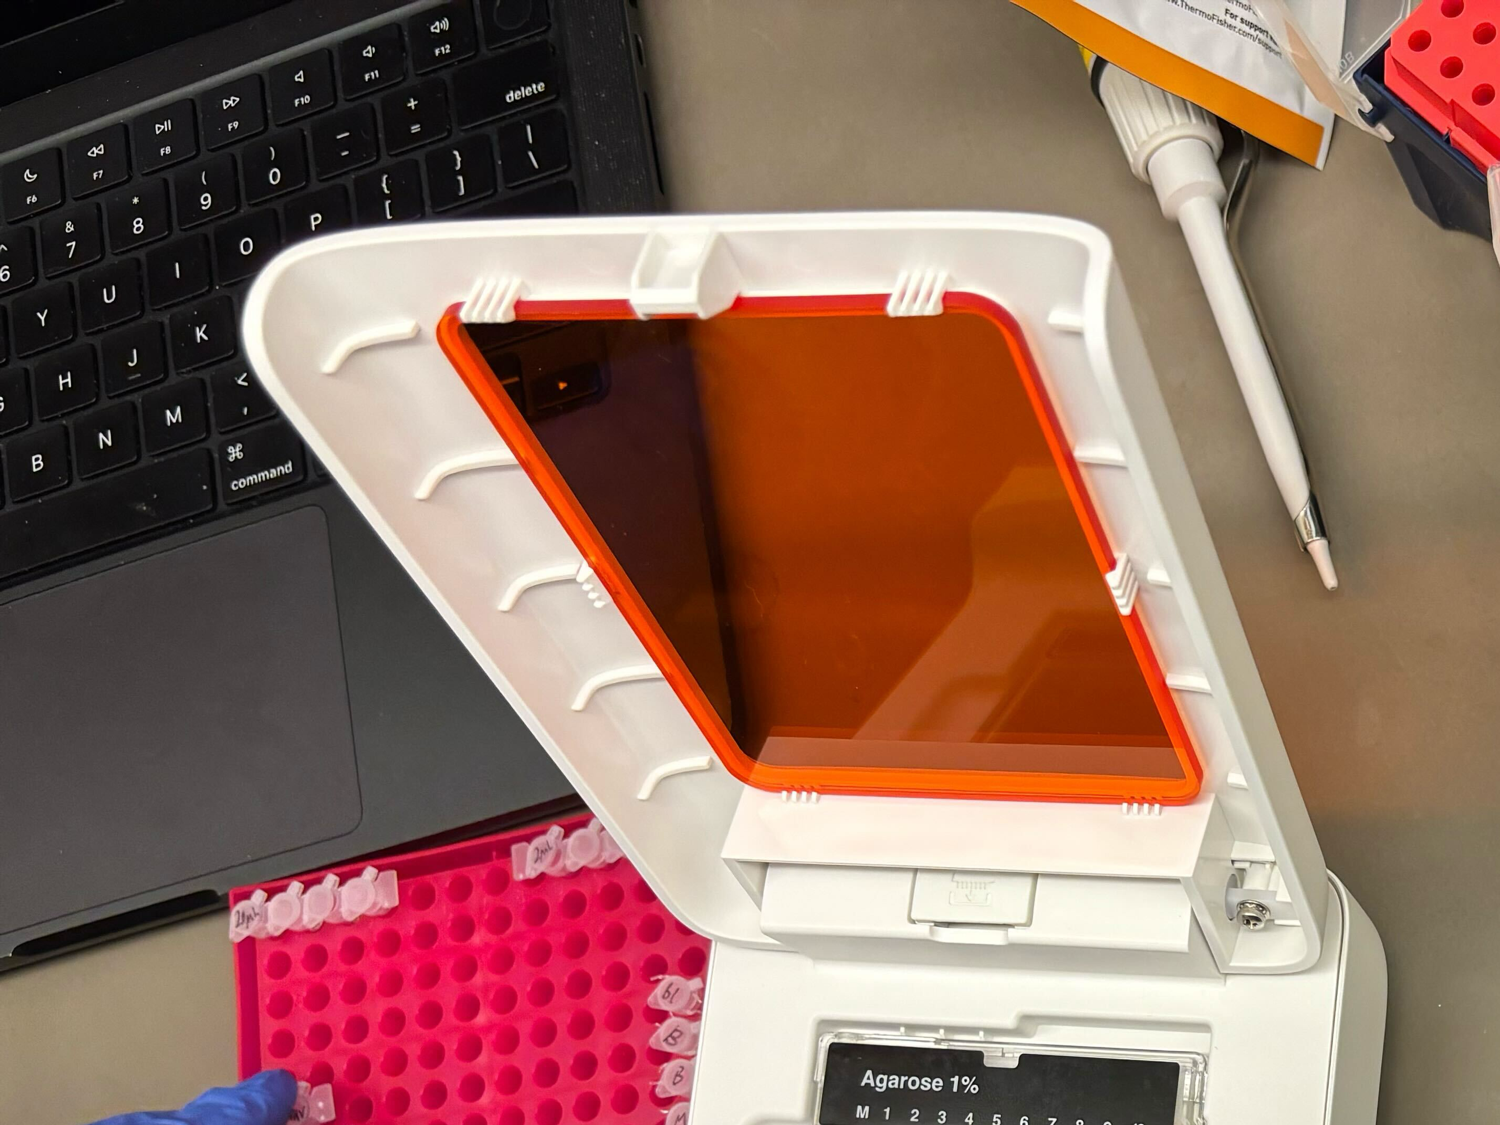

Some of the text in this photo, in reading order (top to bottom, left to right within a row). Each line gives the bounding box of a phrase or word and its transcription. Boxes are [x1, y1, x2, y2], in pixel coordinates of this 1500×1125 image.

[1224, 8, 1239, 21] For
[1239, 16, 1270, 38] support
[434, 44, 451, 57] F12
[364, 69, 380, 82] F11
[294, 94, 311, 108] F10
[505, 80, 545, 103] delete
[227, 120, 239, 132] F9
[160, 145, 172, 157] F8
[92, 169, 104, 181] F7
[26, 194, 38, 205] F6
[200, 192, 212, 210] 9
[132, 217, 145, 235] 8
[310, 212, 322, 232] P
[66, 240, 76, 259] 7
[0, 265, 11, 282] 6
[102, 284, 116, 304] U
[36, 308, 48, 327] Y
[195, 323, 209, 344] K
[127, 348, 138, 367] J
[58, 371, 72, 391] H
[165, 405, 182, 427] M
[98, 429, 112, 450] N
[31, 453, 44, 473] B
[230, 459, 293, 491] command
[860, 1069, 979, 1094] Agarose 1%
[856, 1105, 870, 1119] M
[883, 1106, 891, 1120] 1
[910, 1108, 920, 1122] 2
[937, 1110, 947, 1124] 3
[964, 1112, 974, 1125] 4
